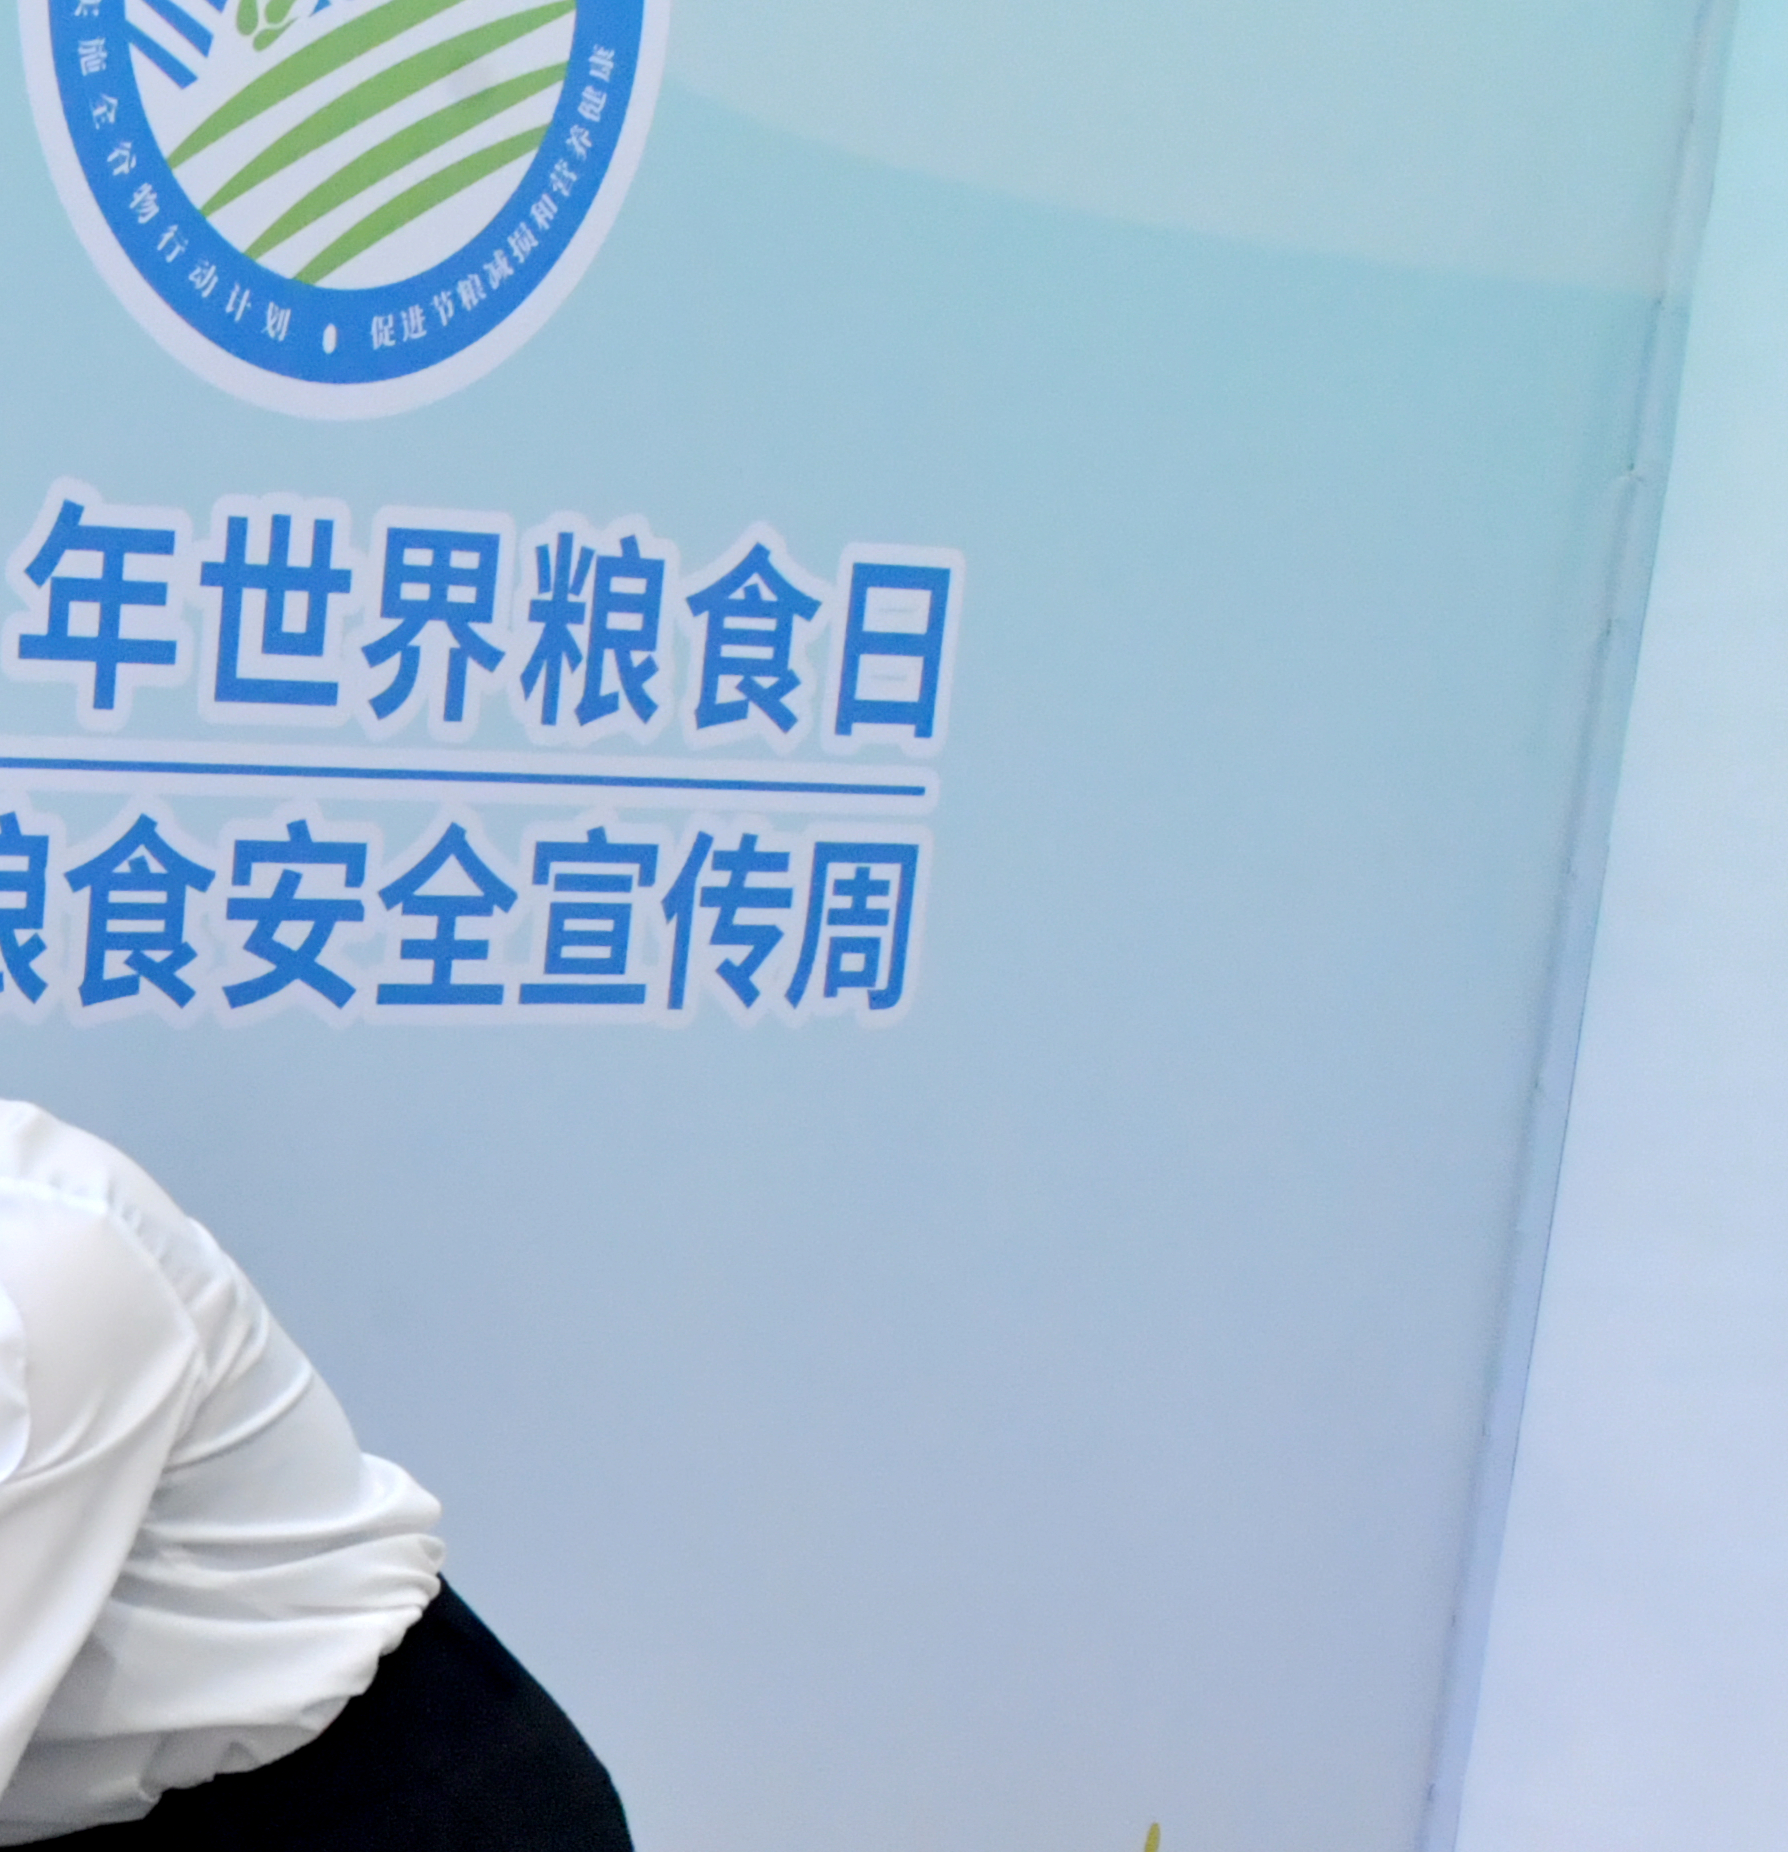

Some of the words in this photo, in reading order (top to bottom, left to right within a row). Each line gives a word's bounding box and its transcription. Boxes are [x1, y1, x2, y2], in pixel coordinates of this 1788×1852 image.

[370, 43, 616, 350] 促进节粮减损和营养健康
